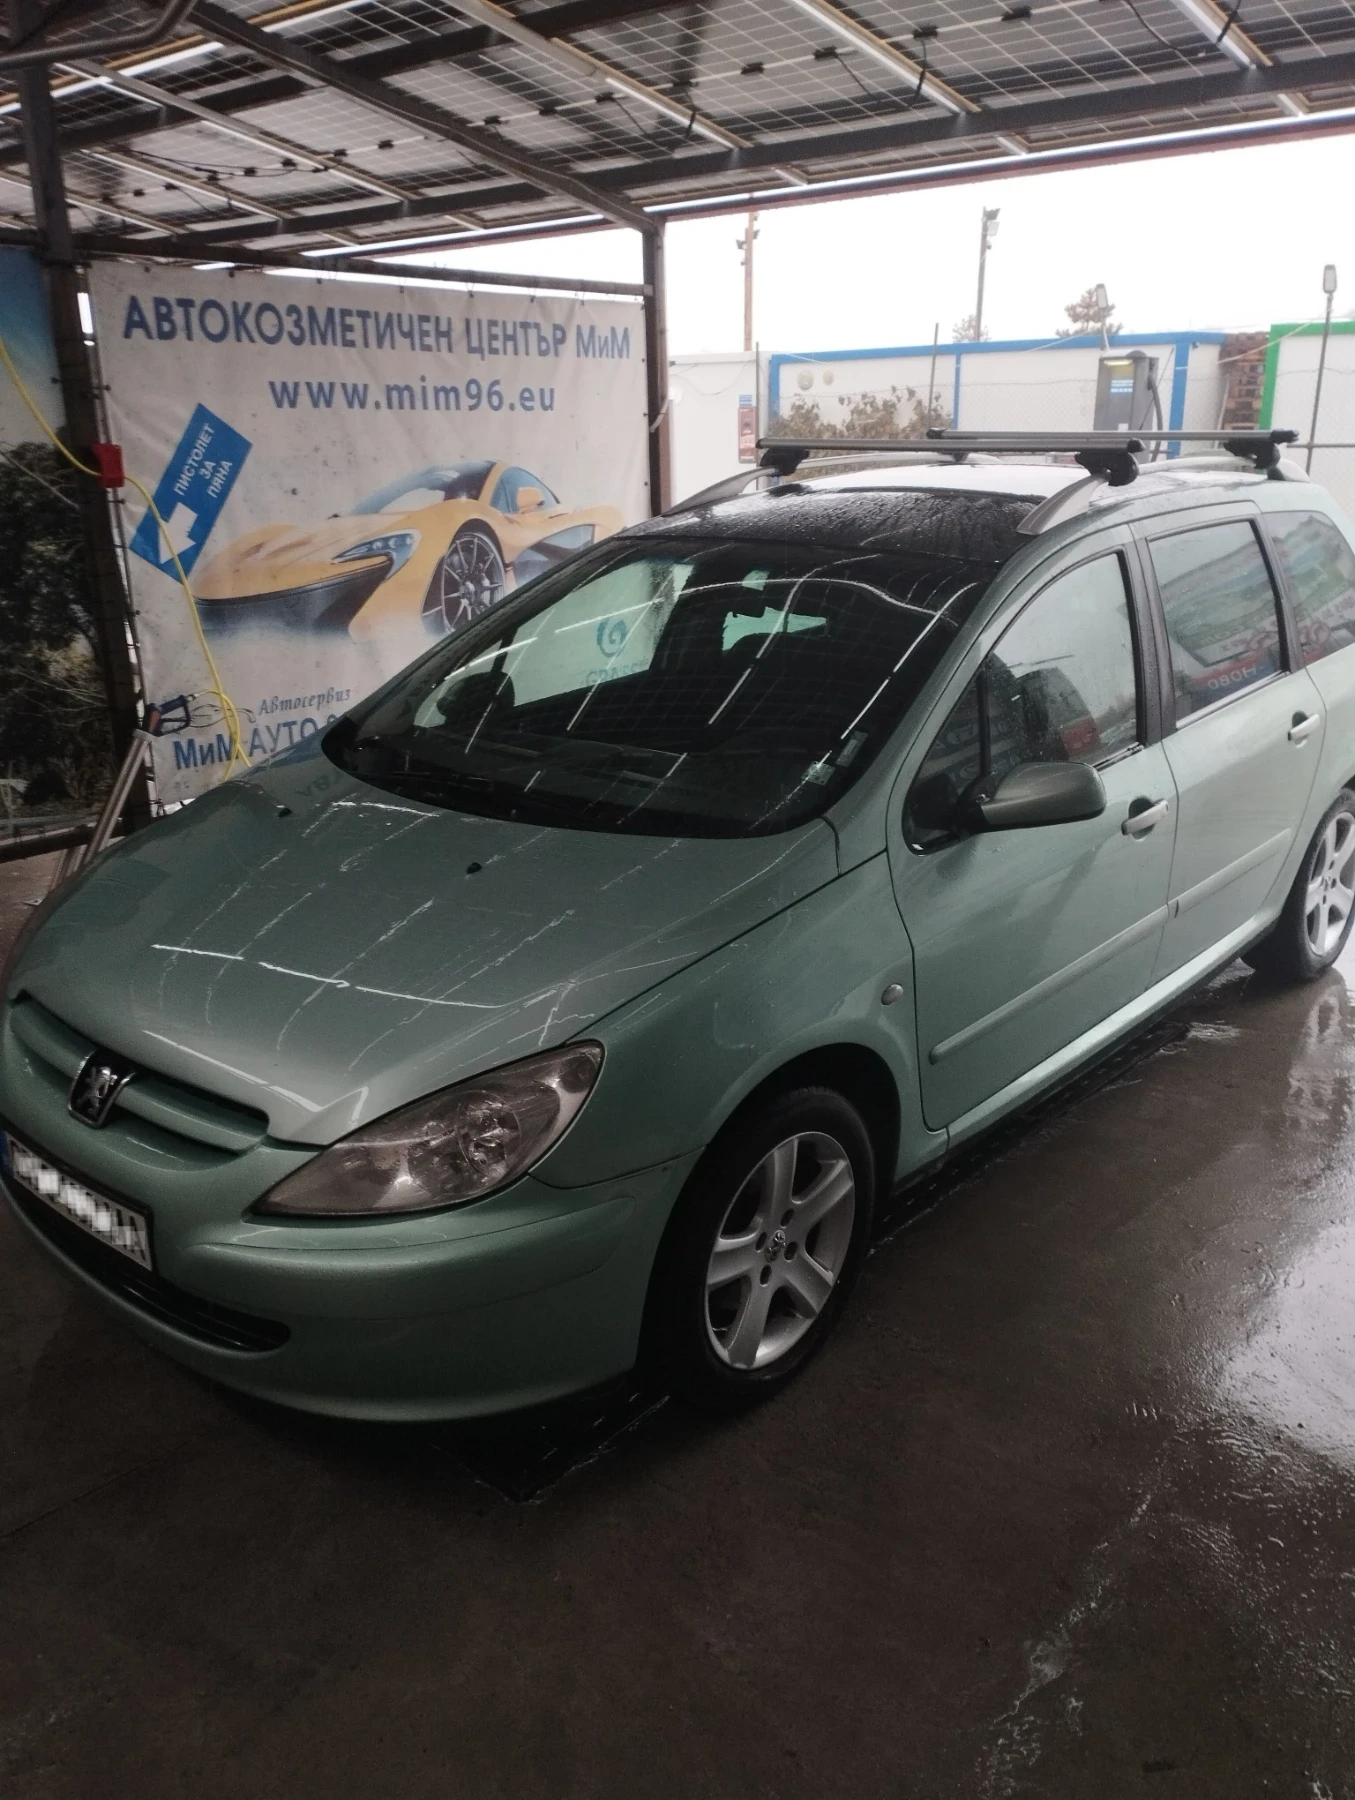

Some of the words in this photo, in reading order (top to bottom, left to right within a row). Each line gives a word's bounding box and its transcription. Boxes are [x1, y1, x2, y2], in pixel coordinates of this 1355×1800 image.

[124, 295, 453, 353] АВТОКОЗМЕТИЧЕН
[465, 317, 566, 361] ЦЕНТЪР
[576, 324, 631, 359] МиМ
[268, 375, 556, 412] www.mim96.eu
[173, 422, 215, 496] ПИСТОЛЕТ
[199, 460, 216, 480] ЗА
[206, 460, 233, 498] ПЯНА
[258, 687, 352, 716] Автосервиз
[173, 733, 239, 771] МиМ
